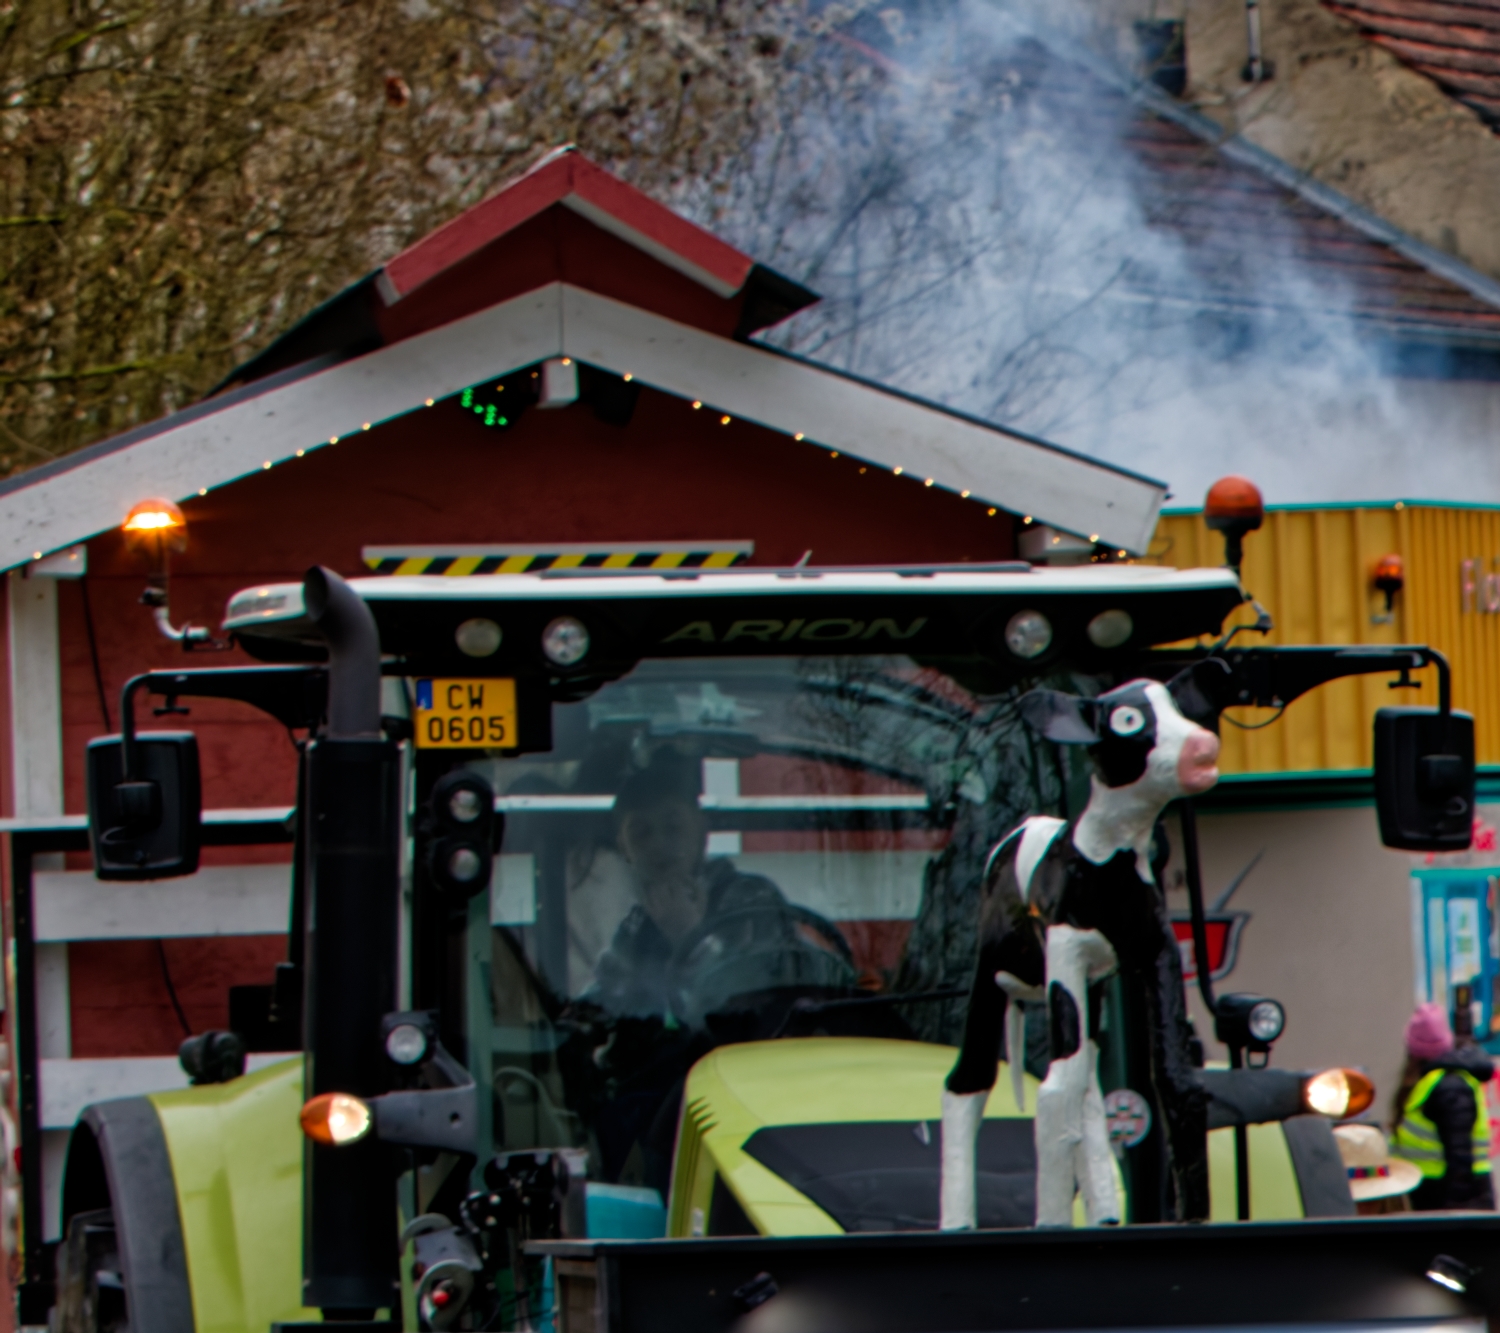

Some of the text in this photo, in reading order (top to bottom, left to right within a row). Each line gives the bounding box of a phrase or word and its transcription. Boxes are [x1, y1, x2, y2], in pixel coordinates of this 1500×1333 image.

[660, 617, 929, 644] ARION
[446, 684, 485, 711] CW
[427, 716, 505, 743] 0605
